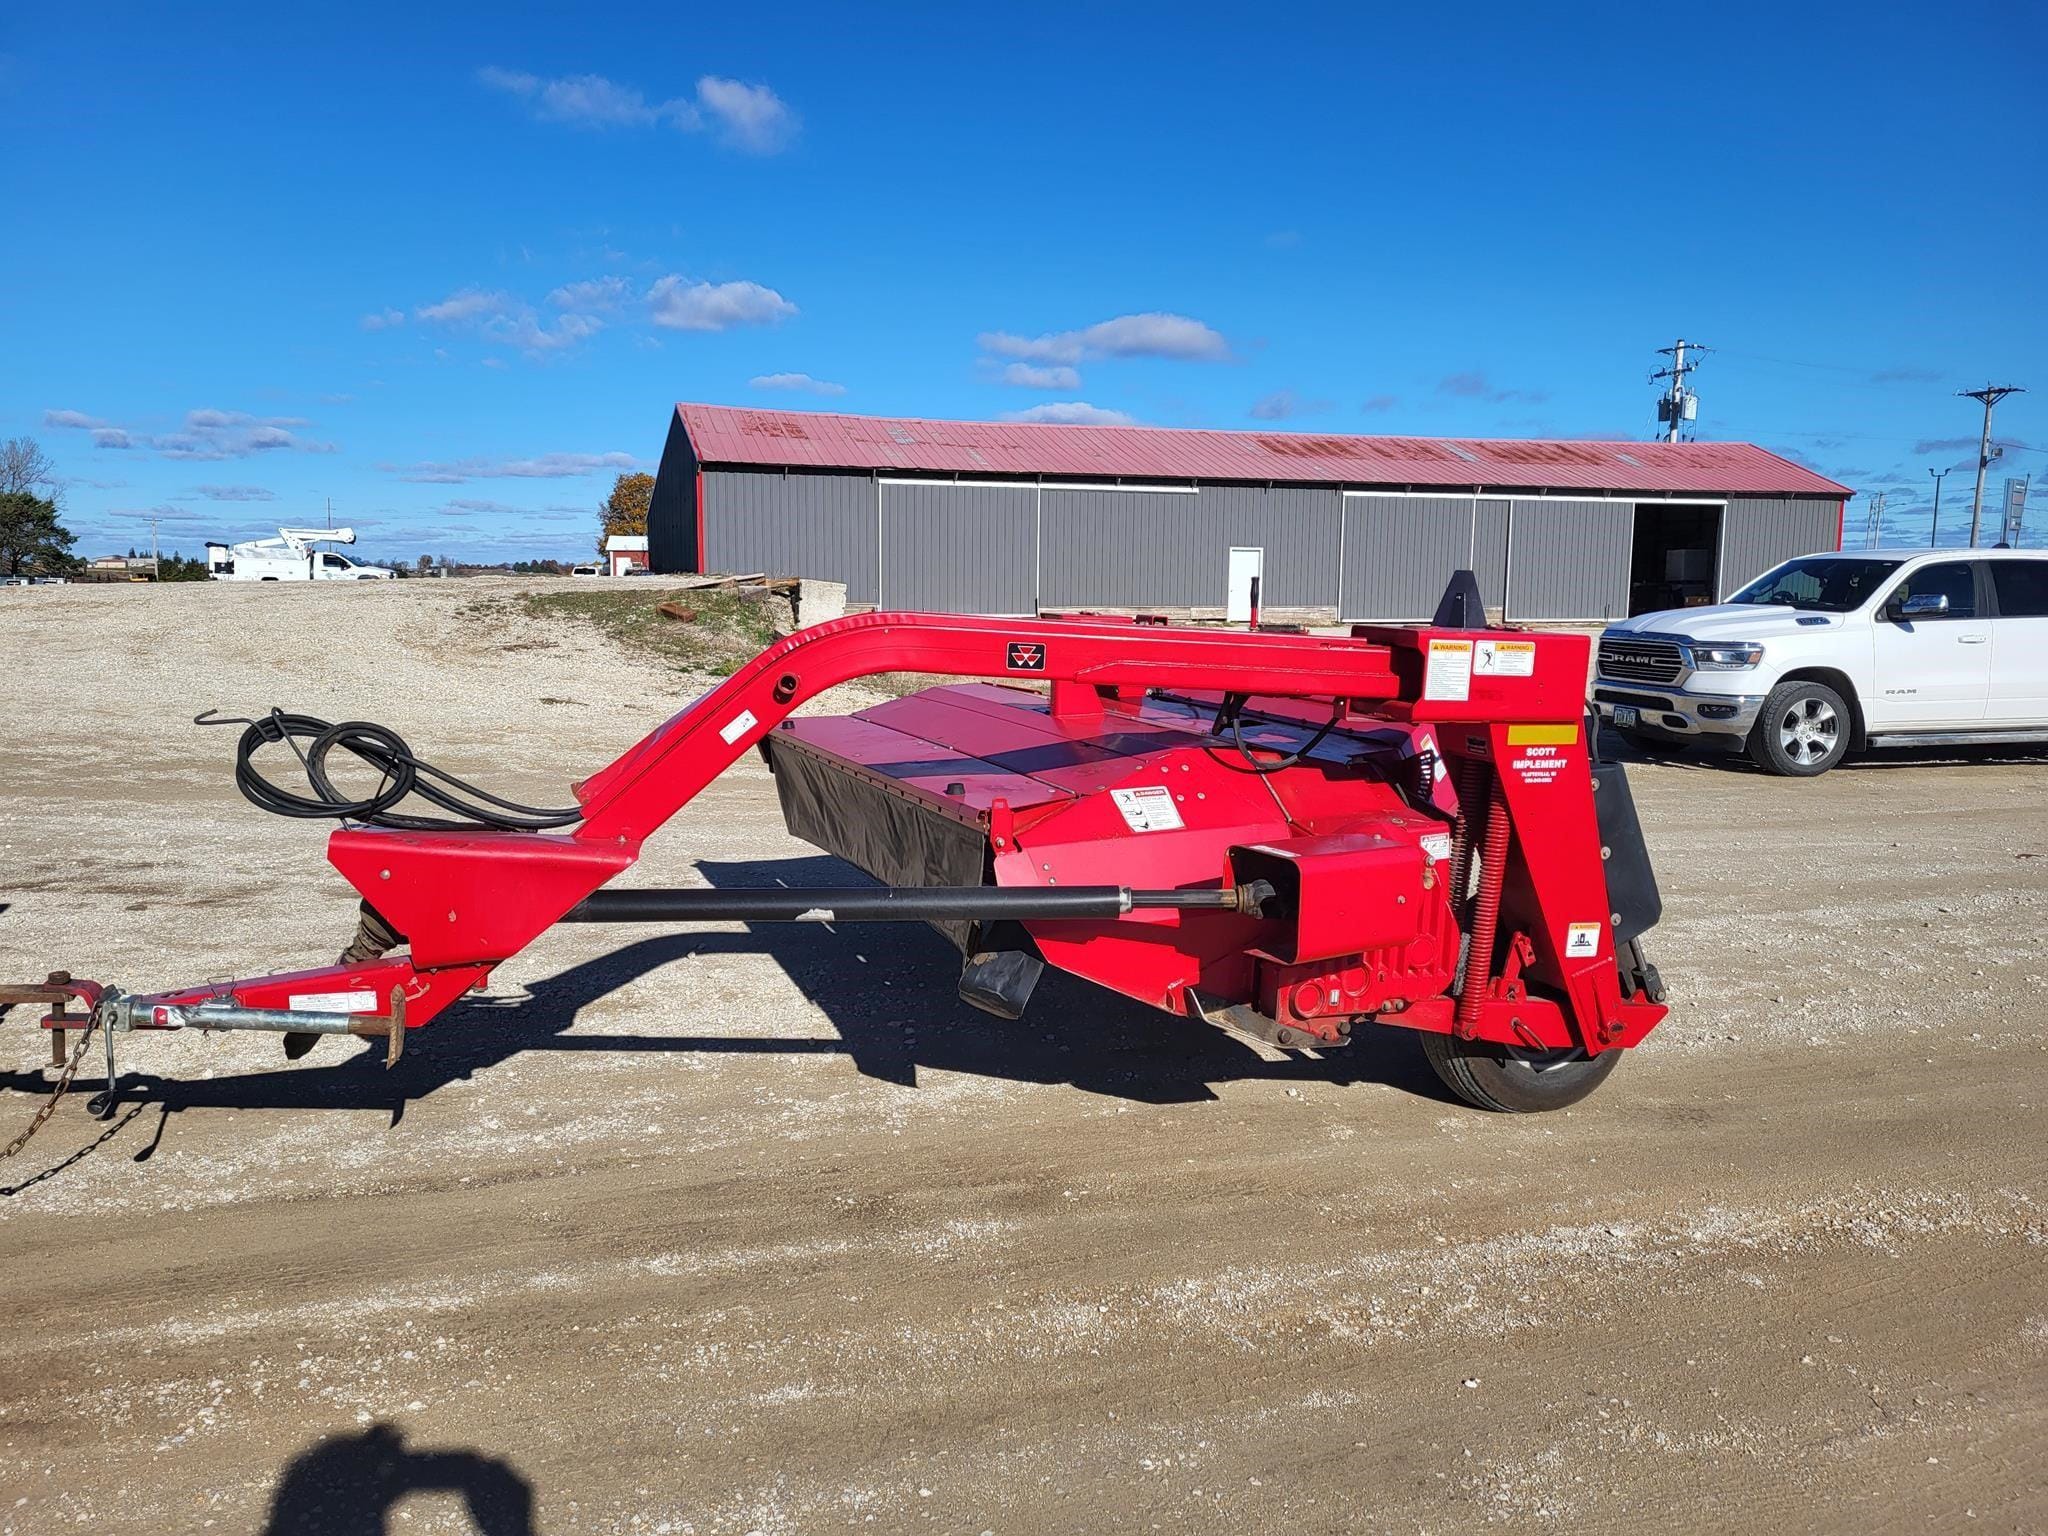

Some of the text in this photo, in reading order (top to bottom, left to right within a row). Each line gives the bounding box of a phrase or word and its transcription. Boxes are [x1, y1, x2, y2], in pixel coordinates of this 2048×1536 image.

[1440, 643, 1468, 651] WARNING
[1614, 654, 1649, 664] RAM
[1526, 747, 1557, 756] SCOTT
[1512, 759, 1568, 769] IMPLEMENT
